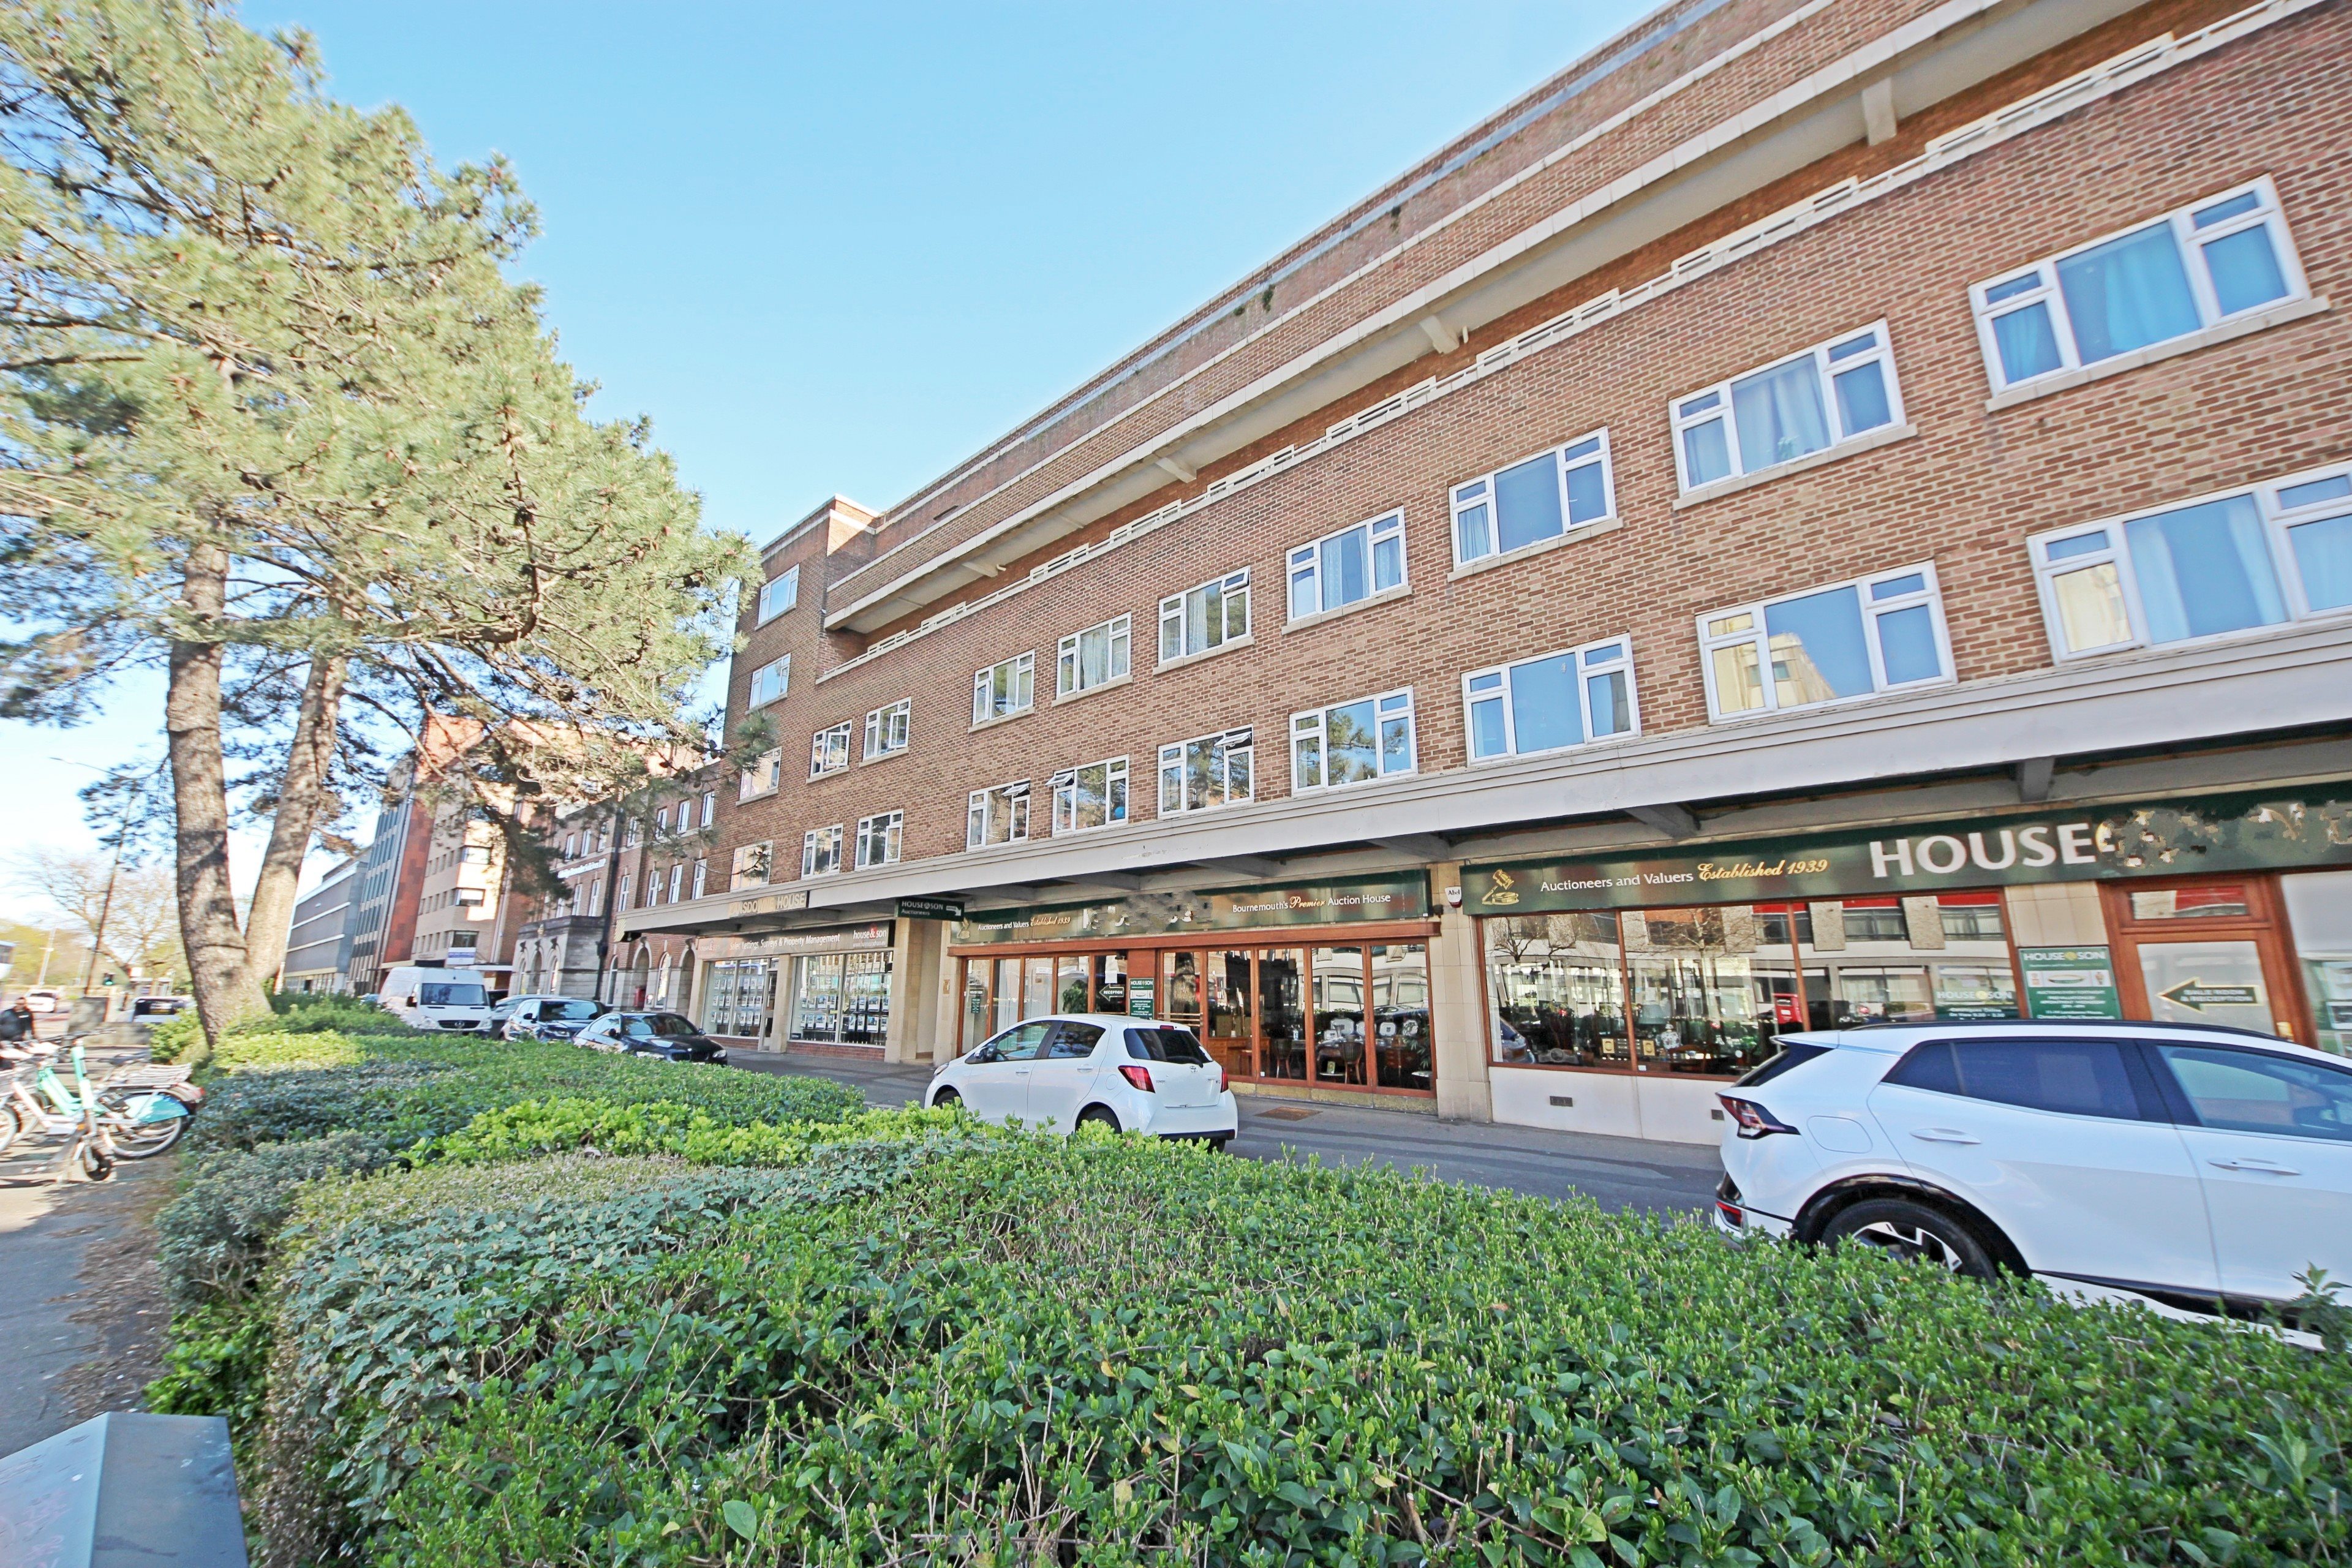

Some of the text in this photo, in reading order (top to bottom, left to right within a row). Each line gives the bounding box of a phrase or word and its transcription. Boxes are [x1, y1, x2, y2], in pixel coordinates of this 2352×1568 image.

[1869, 823, 2097, 878] HOUSE
[1540, 859, 1828, 892] Auctioneers and Valuers Established 1939
[777, 893, 805, 909] HOUSE
[1232, 894, 1391, 913] Bournemouth's Premier Auction House
[978, 922, 1003, 931] Auctioneers
[783, 937, 805, 947] Property
[805, 933, 841, 946] Management
[2023, 951, 2106, 960] HOUSE SON
